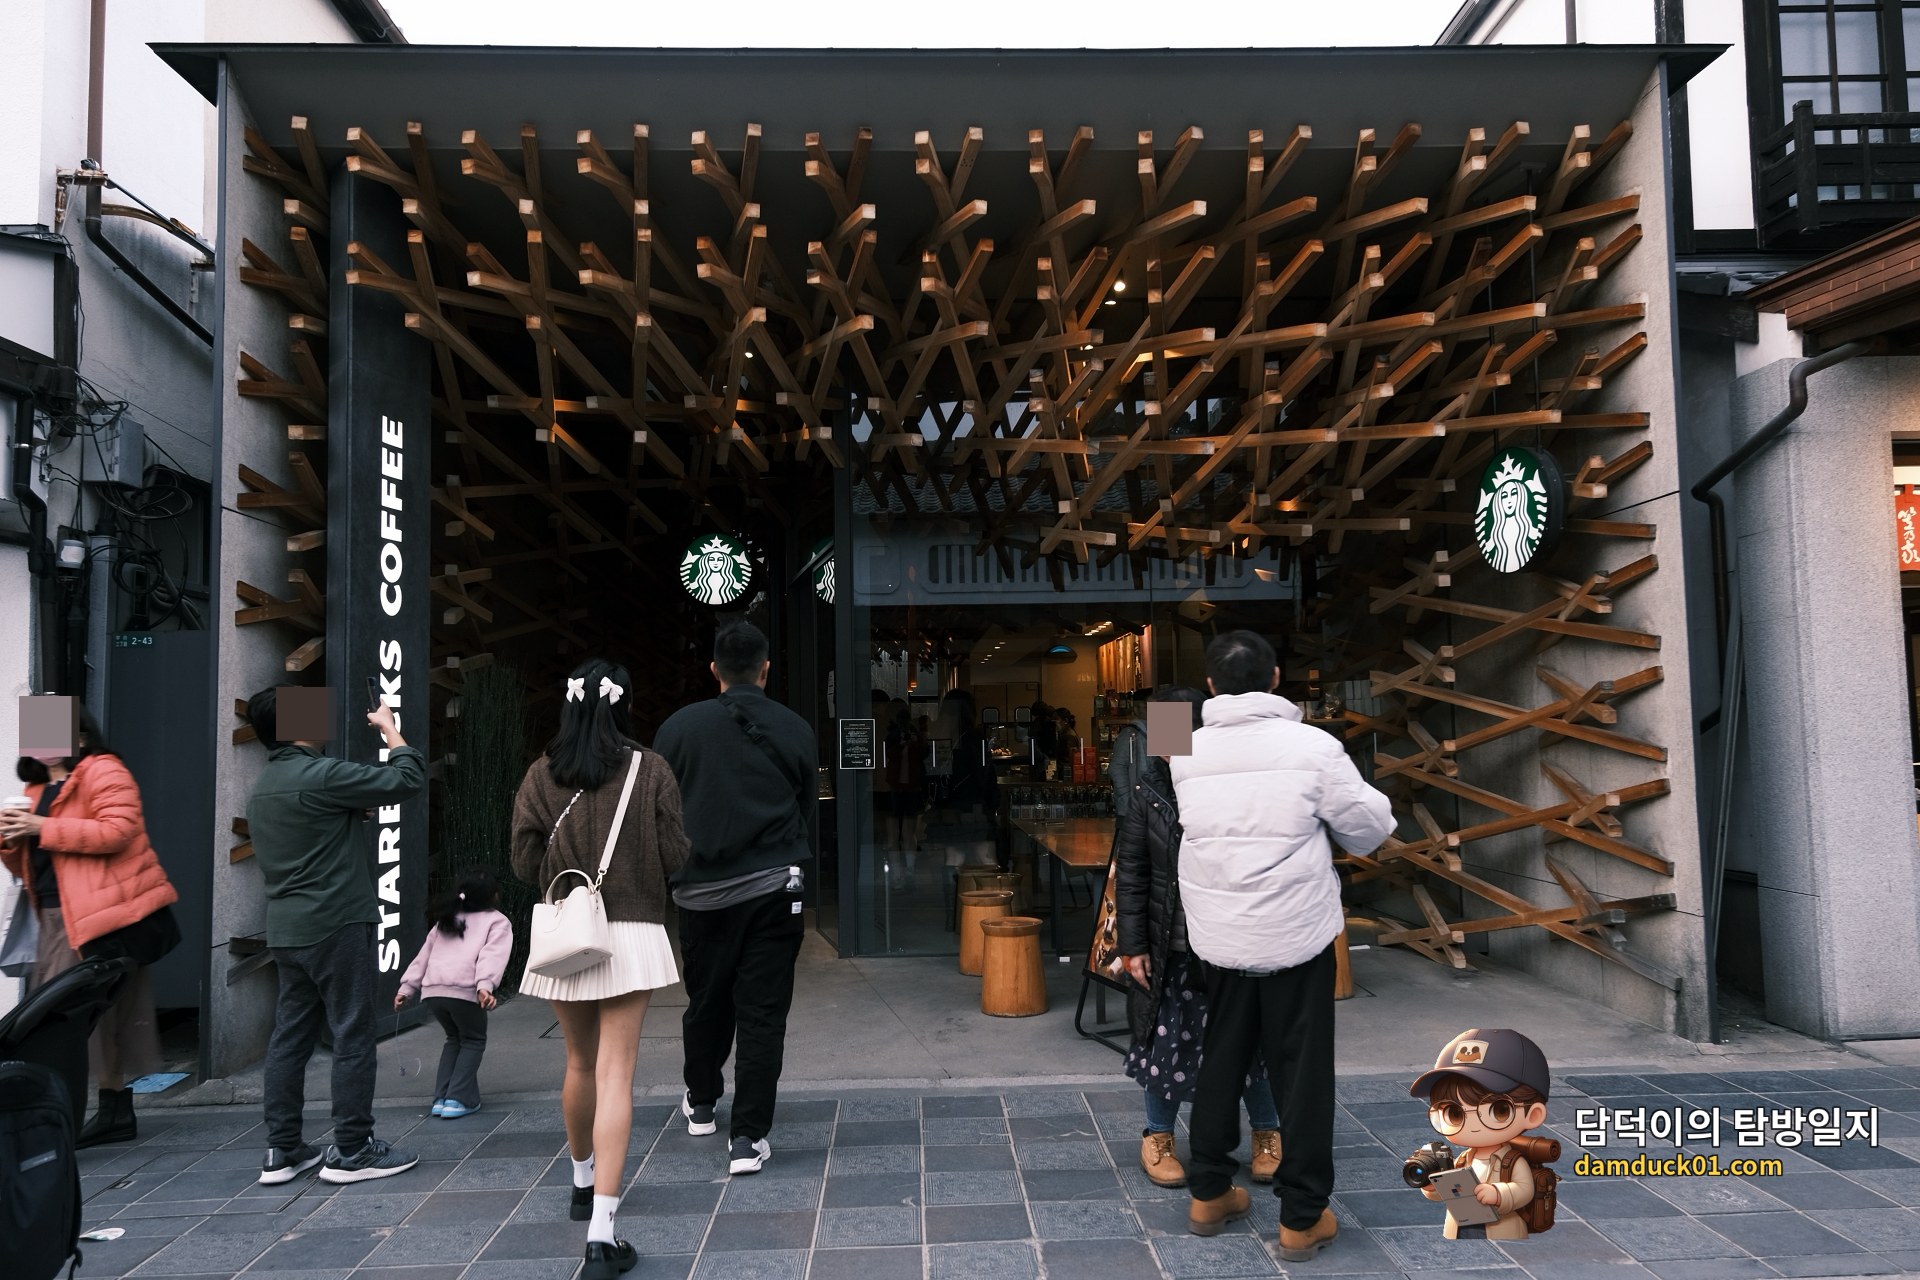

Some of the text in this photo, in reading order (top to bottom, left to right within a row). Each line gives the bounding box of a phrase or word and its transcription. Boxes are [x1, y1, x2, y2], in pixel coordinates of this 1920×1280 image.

[131, 637, 153, 645] 2-43
[377, 415, 403, 973] STARBKS COFFEE
